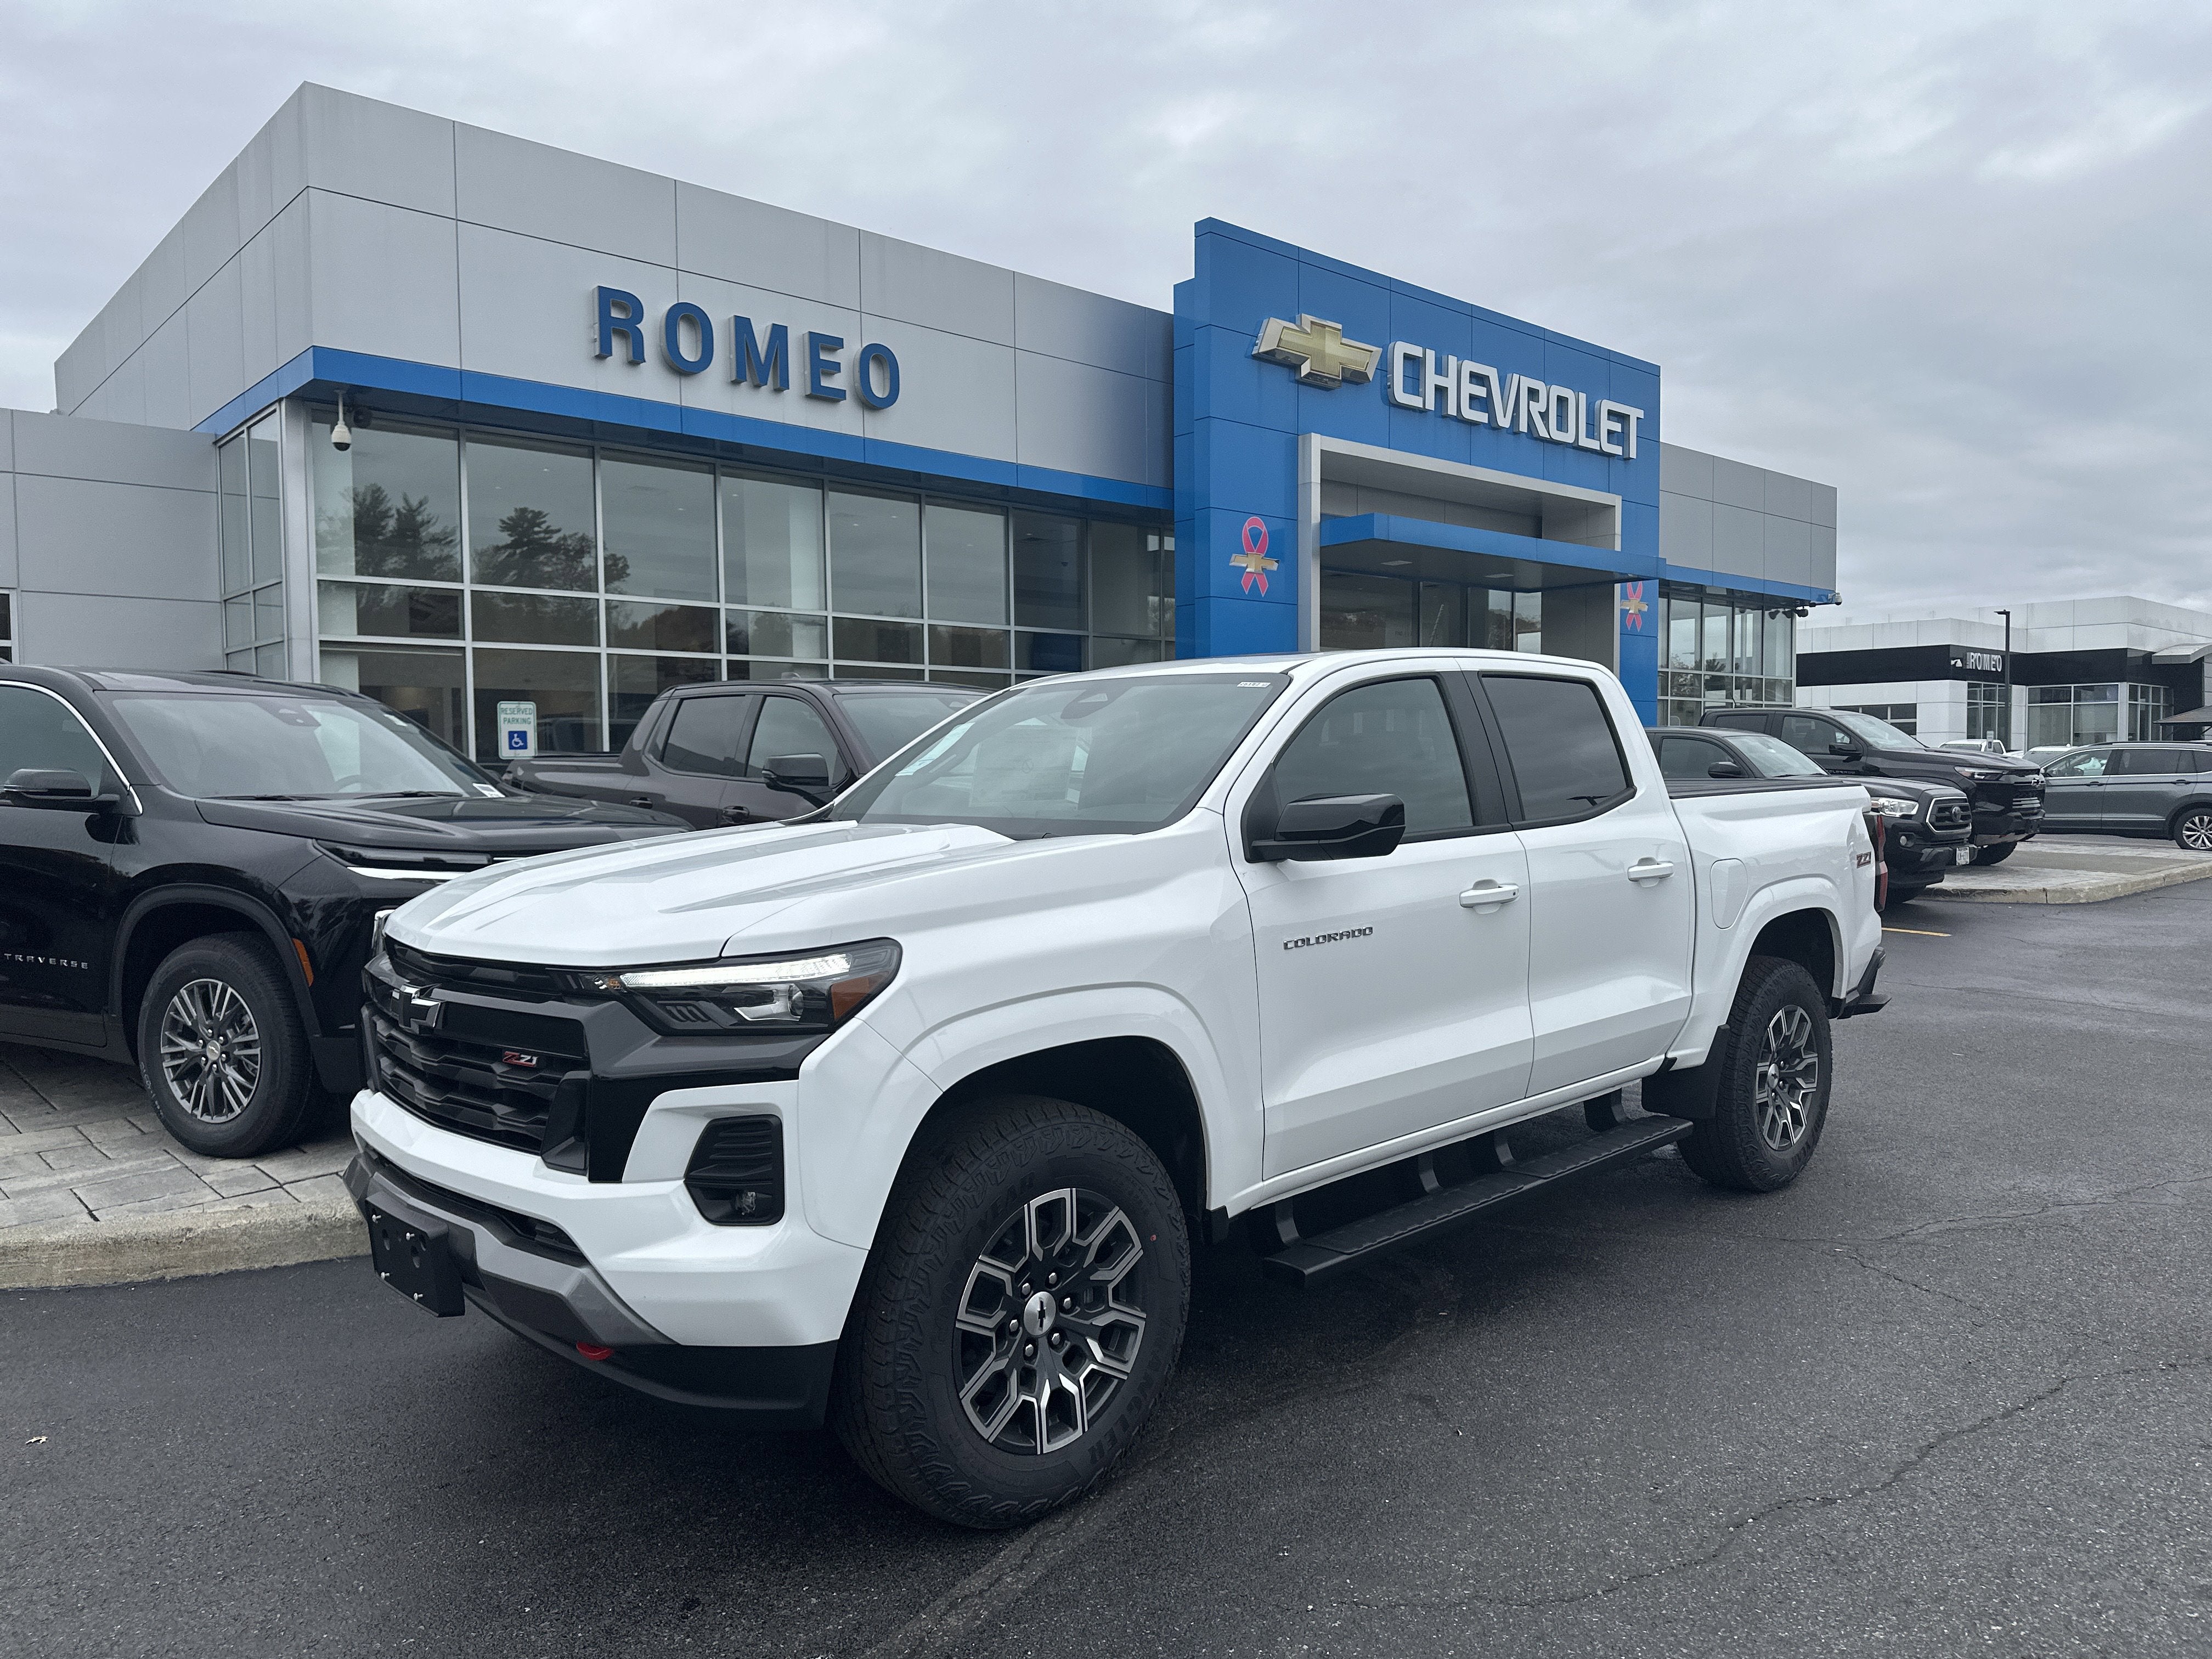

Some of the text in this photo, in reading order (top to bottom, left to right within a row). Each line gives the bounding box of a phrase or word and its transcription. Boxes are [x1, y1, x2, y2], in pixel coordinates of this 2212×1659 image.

[594, 285, 900, 410] ROMEO
[1388, 340, 1644, 460] CHEVROLET
[1967, 652, 2002, 672] ROMEO
[1857, 851, 1871, 868] Z71
[1283, 926, 1373, 950] COLORADO
[4, 953, 88, 969] TRAVERSE
[502, 1051, 539, 1068] Z71
